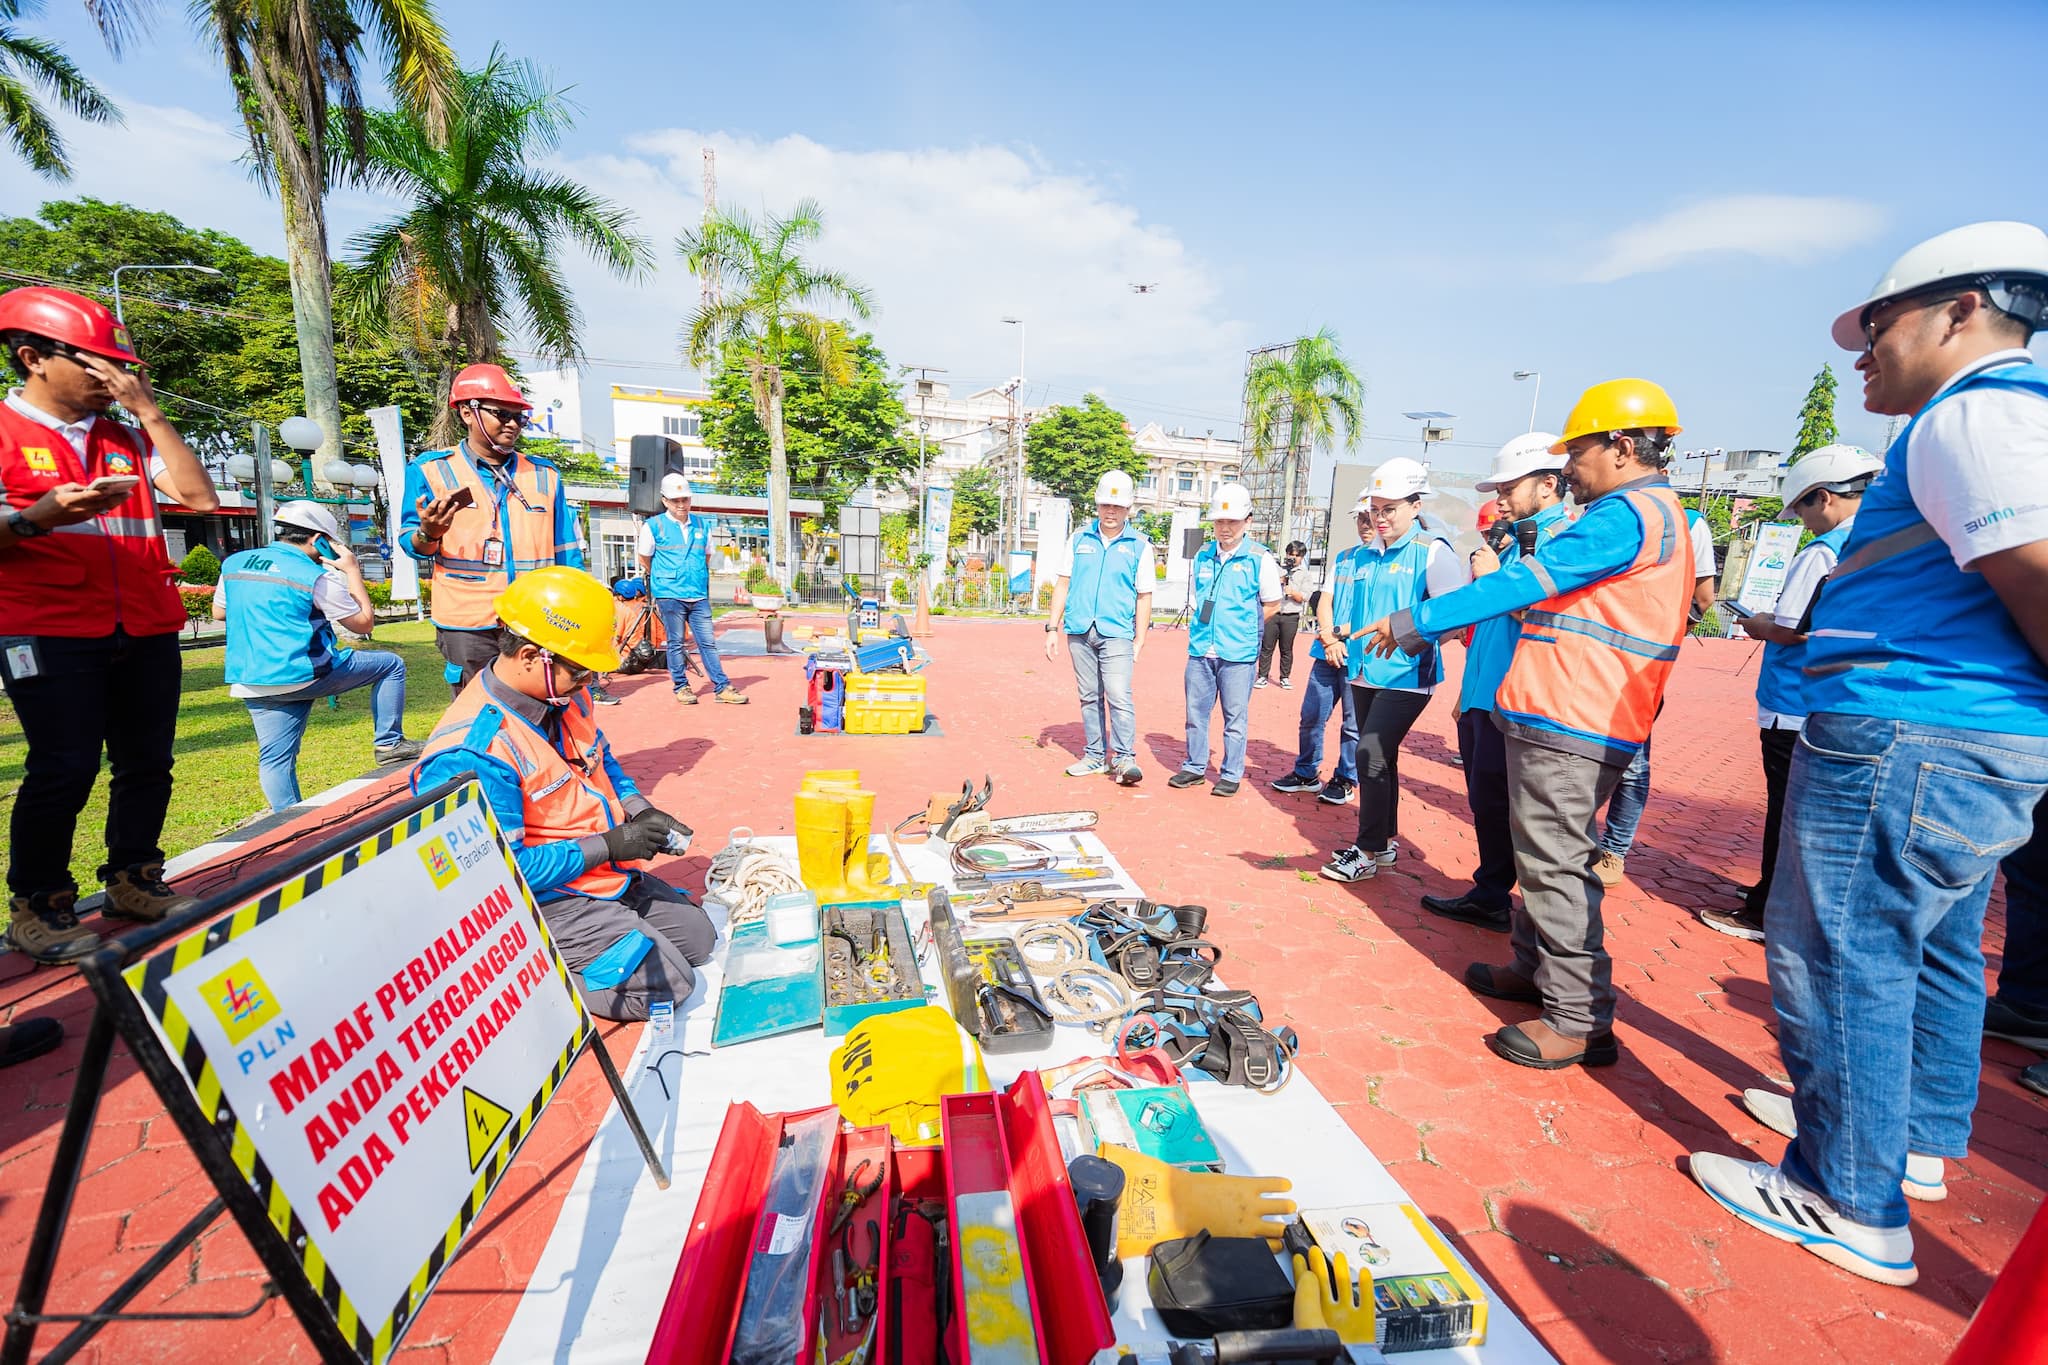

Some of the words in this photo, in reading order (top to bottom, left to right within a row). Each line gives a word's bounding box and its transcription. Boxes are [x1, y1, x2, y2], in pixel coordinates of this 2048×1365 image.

[542, 607, 581, 630] PELAYANAN
[546, 616, 570, 632] TEKNIK
[446, 815, 484, 853] PLN
[456, 840, 494, 872] Tarakan
[268, 1001, 375, 1116] MAAF
[374, 884, 514, 1022] PERJALANAN
[237, 1019, 296, 1075] PLN
[304, 1050, 404, 1165] ANDA
[397, 920, 528, 1063] TERGANGGU
[316, 1132, 395, 1233] ADA
[387, 983, 522, 1146] PEKERJAAN
[516, 947, 551, 999] PLN
